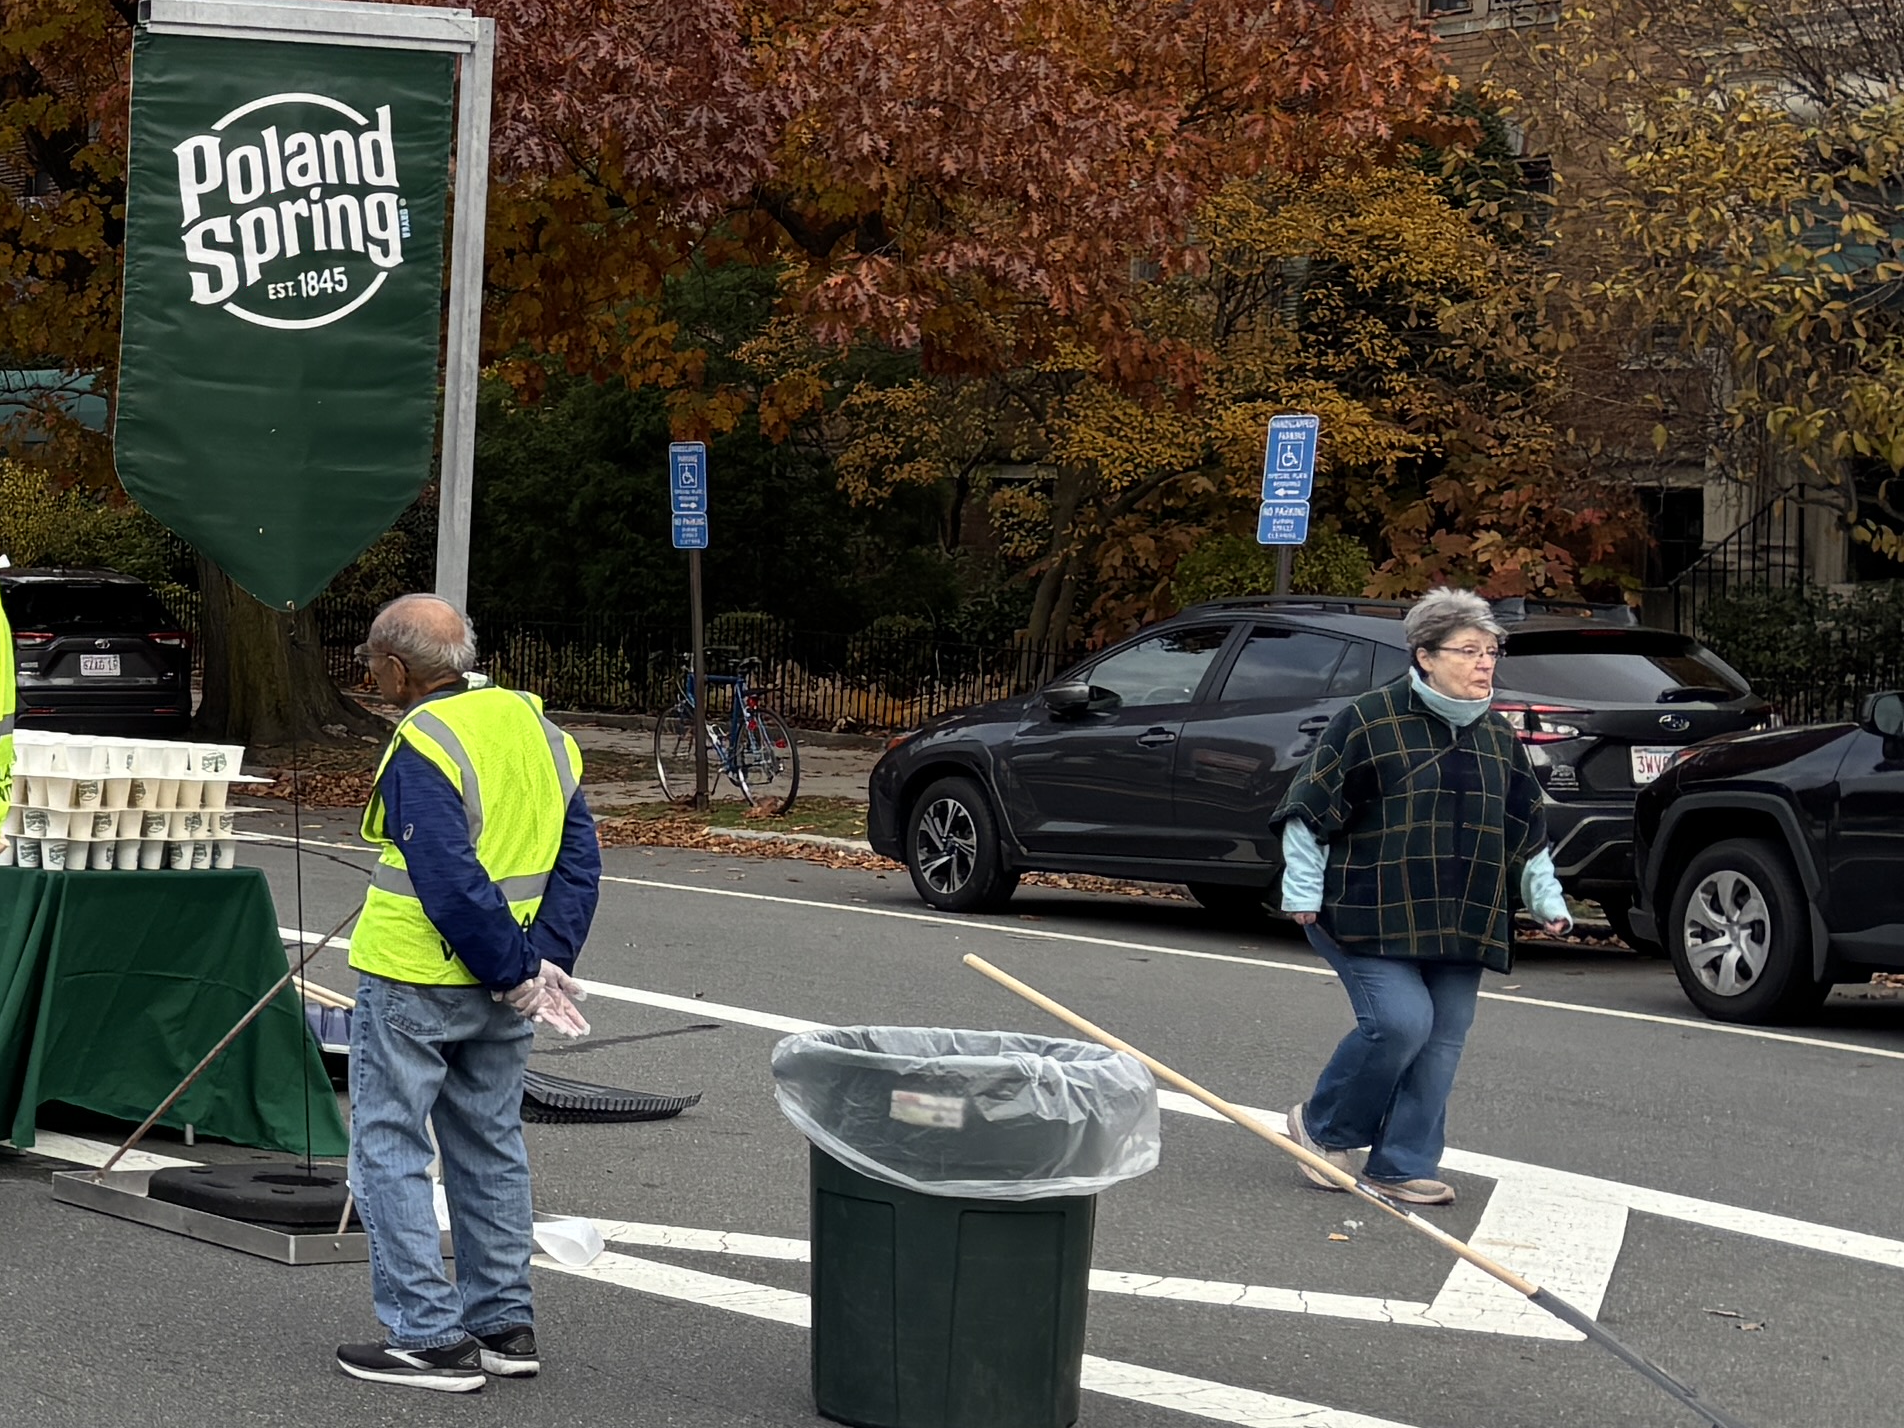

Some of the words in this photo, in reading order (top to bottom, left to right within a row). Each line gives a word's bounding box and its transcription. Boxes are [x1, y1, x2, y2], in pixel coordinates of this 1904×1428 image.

[173, 104, 399, 228] Poland
[181, 187, 404, 305] Spring
[267, 281, 297, 300] EST.
[297, 267, 348, 298] 1845
